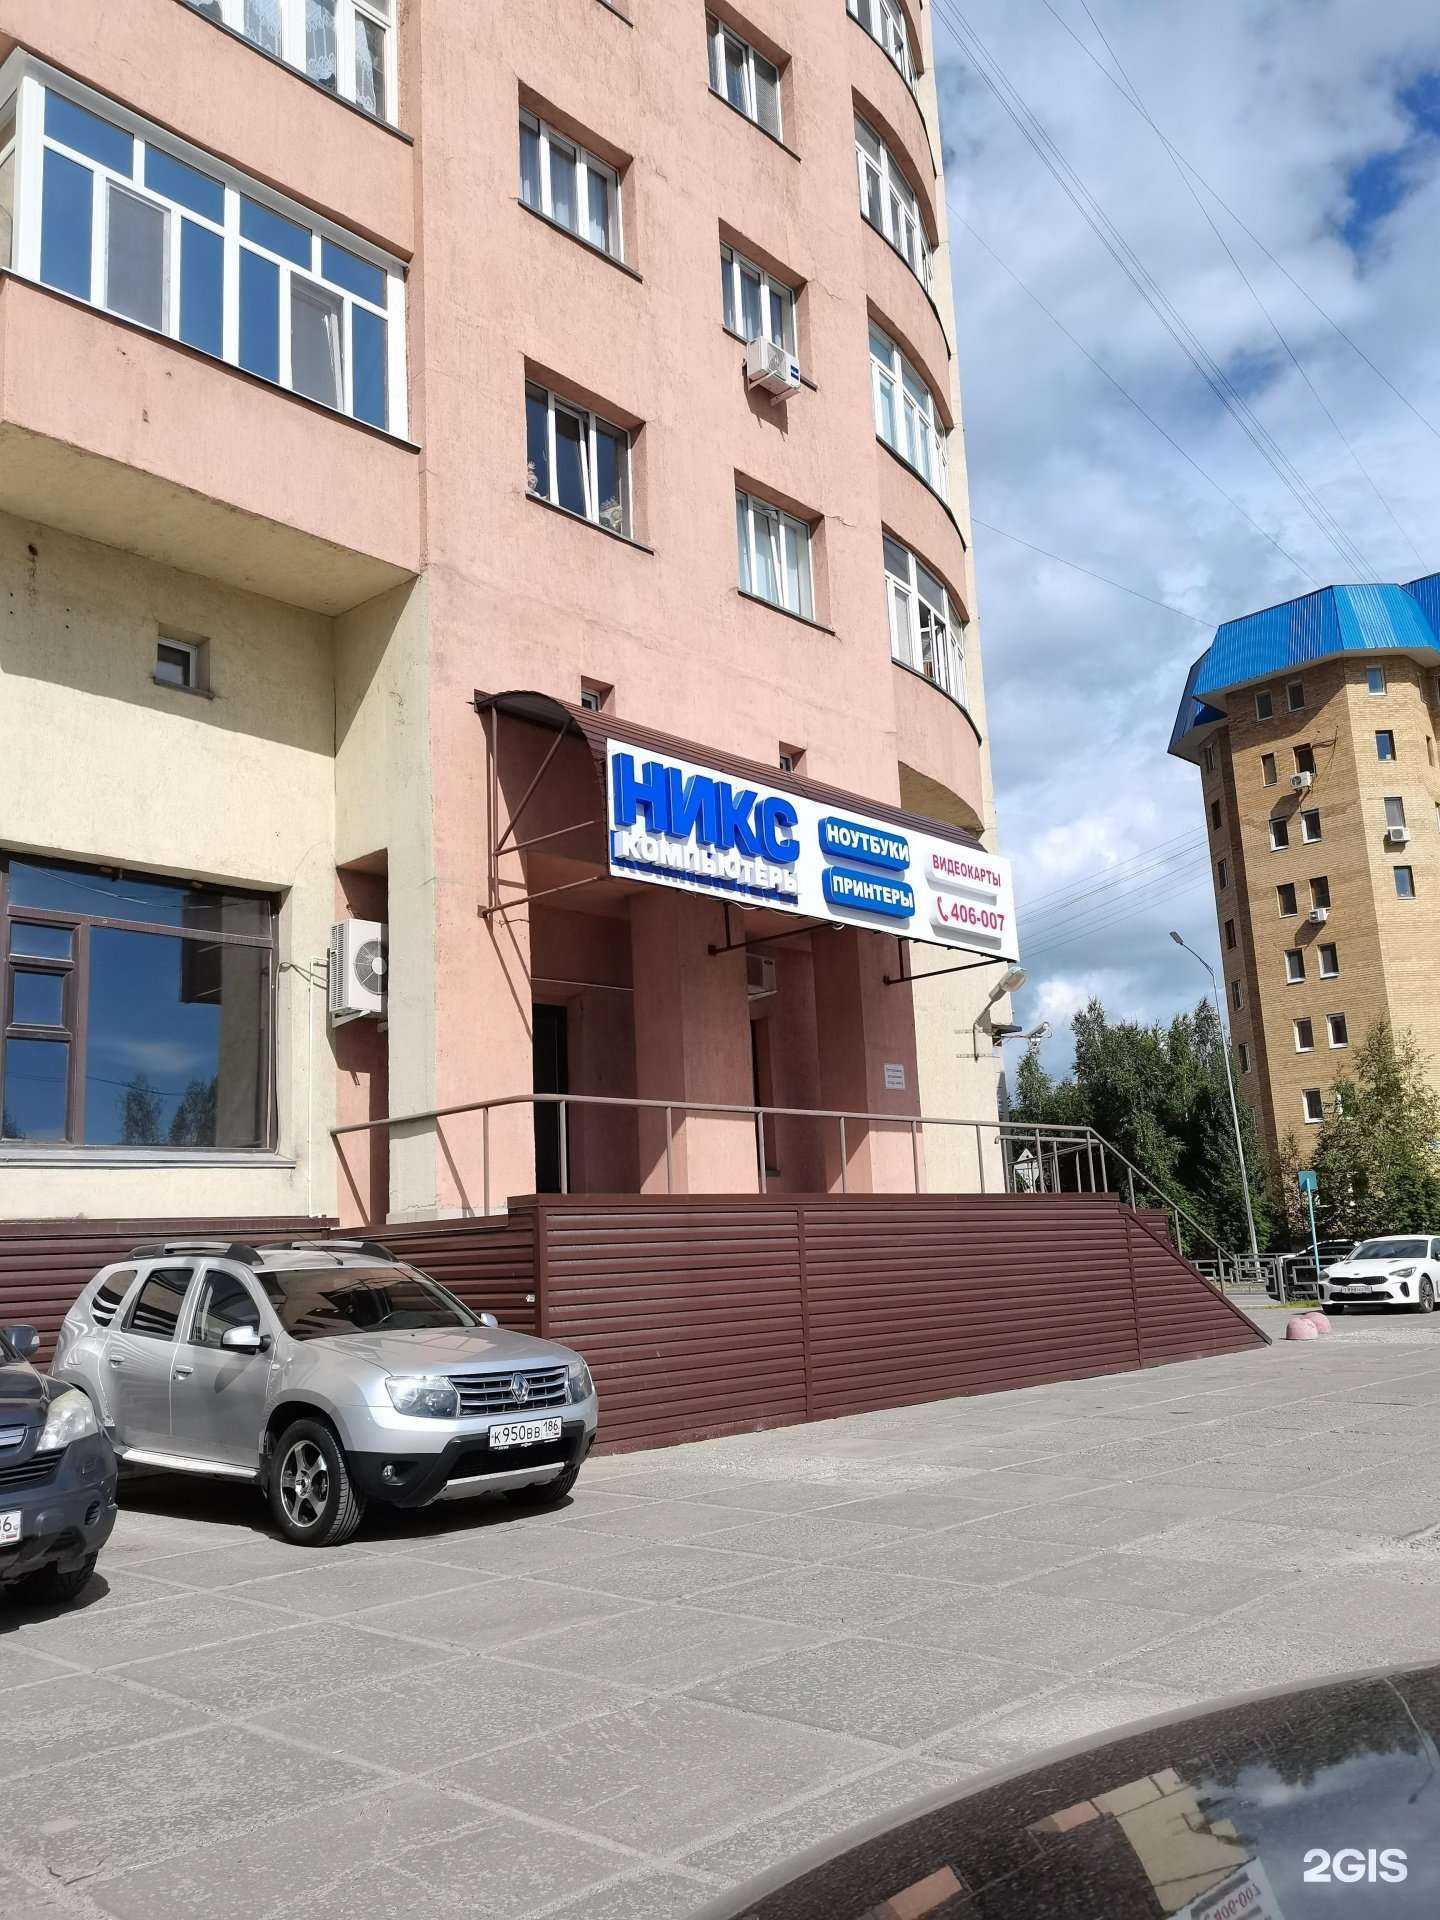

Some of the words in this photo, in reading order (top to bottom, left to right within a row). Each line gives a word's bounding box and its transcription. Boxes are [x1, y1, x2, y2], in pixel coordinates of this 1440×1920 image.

[612, 752, 800, 864] НИКС
[826, 823, 910, 863] НОУТБУКИ
[612, 830, 798, 899] КОМПЬЮТЕРЫ
[932, 854, 1001, 888] ВИДЕОКАРТЫ
[832, 875, 913, 909] ПРИНТЕРЫ
[951, 903, 1005, 932] 406-007
